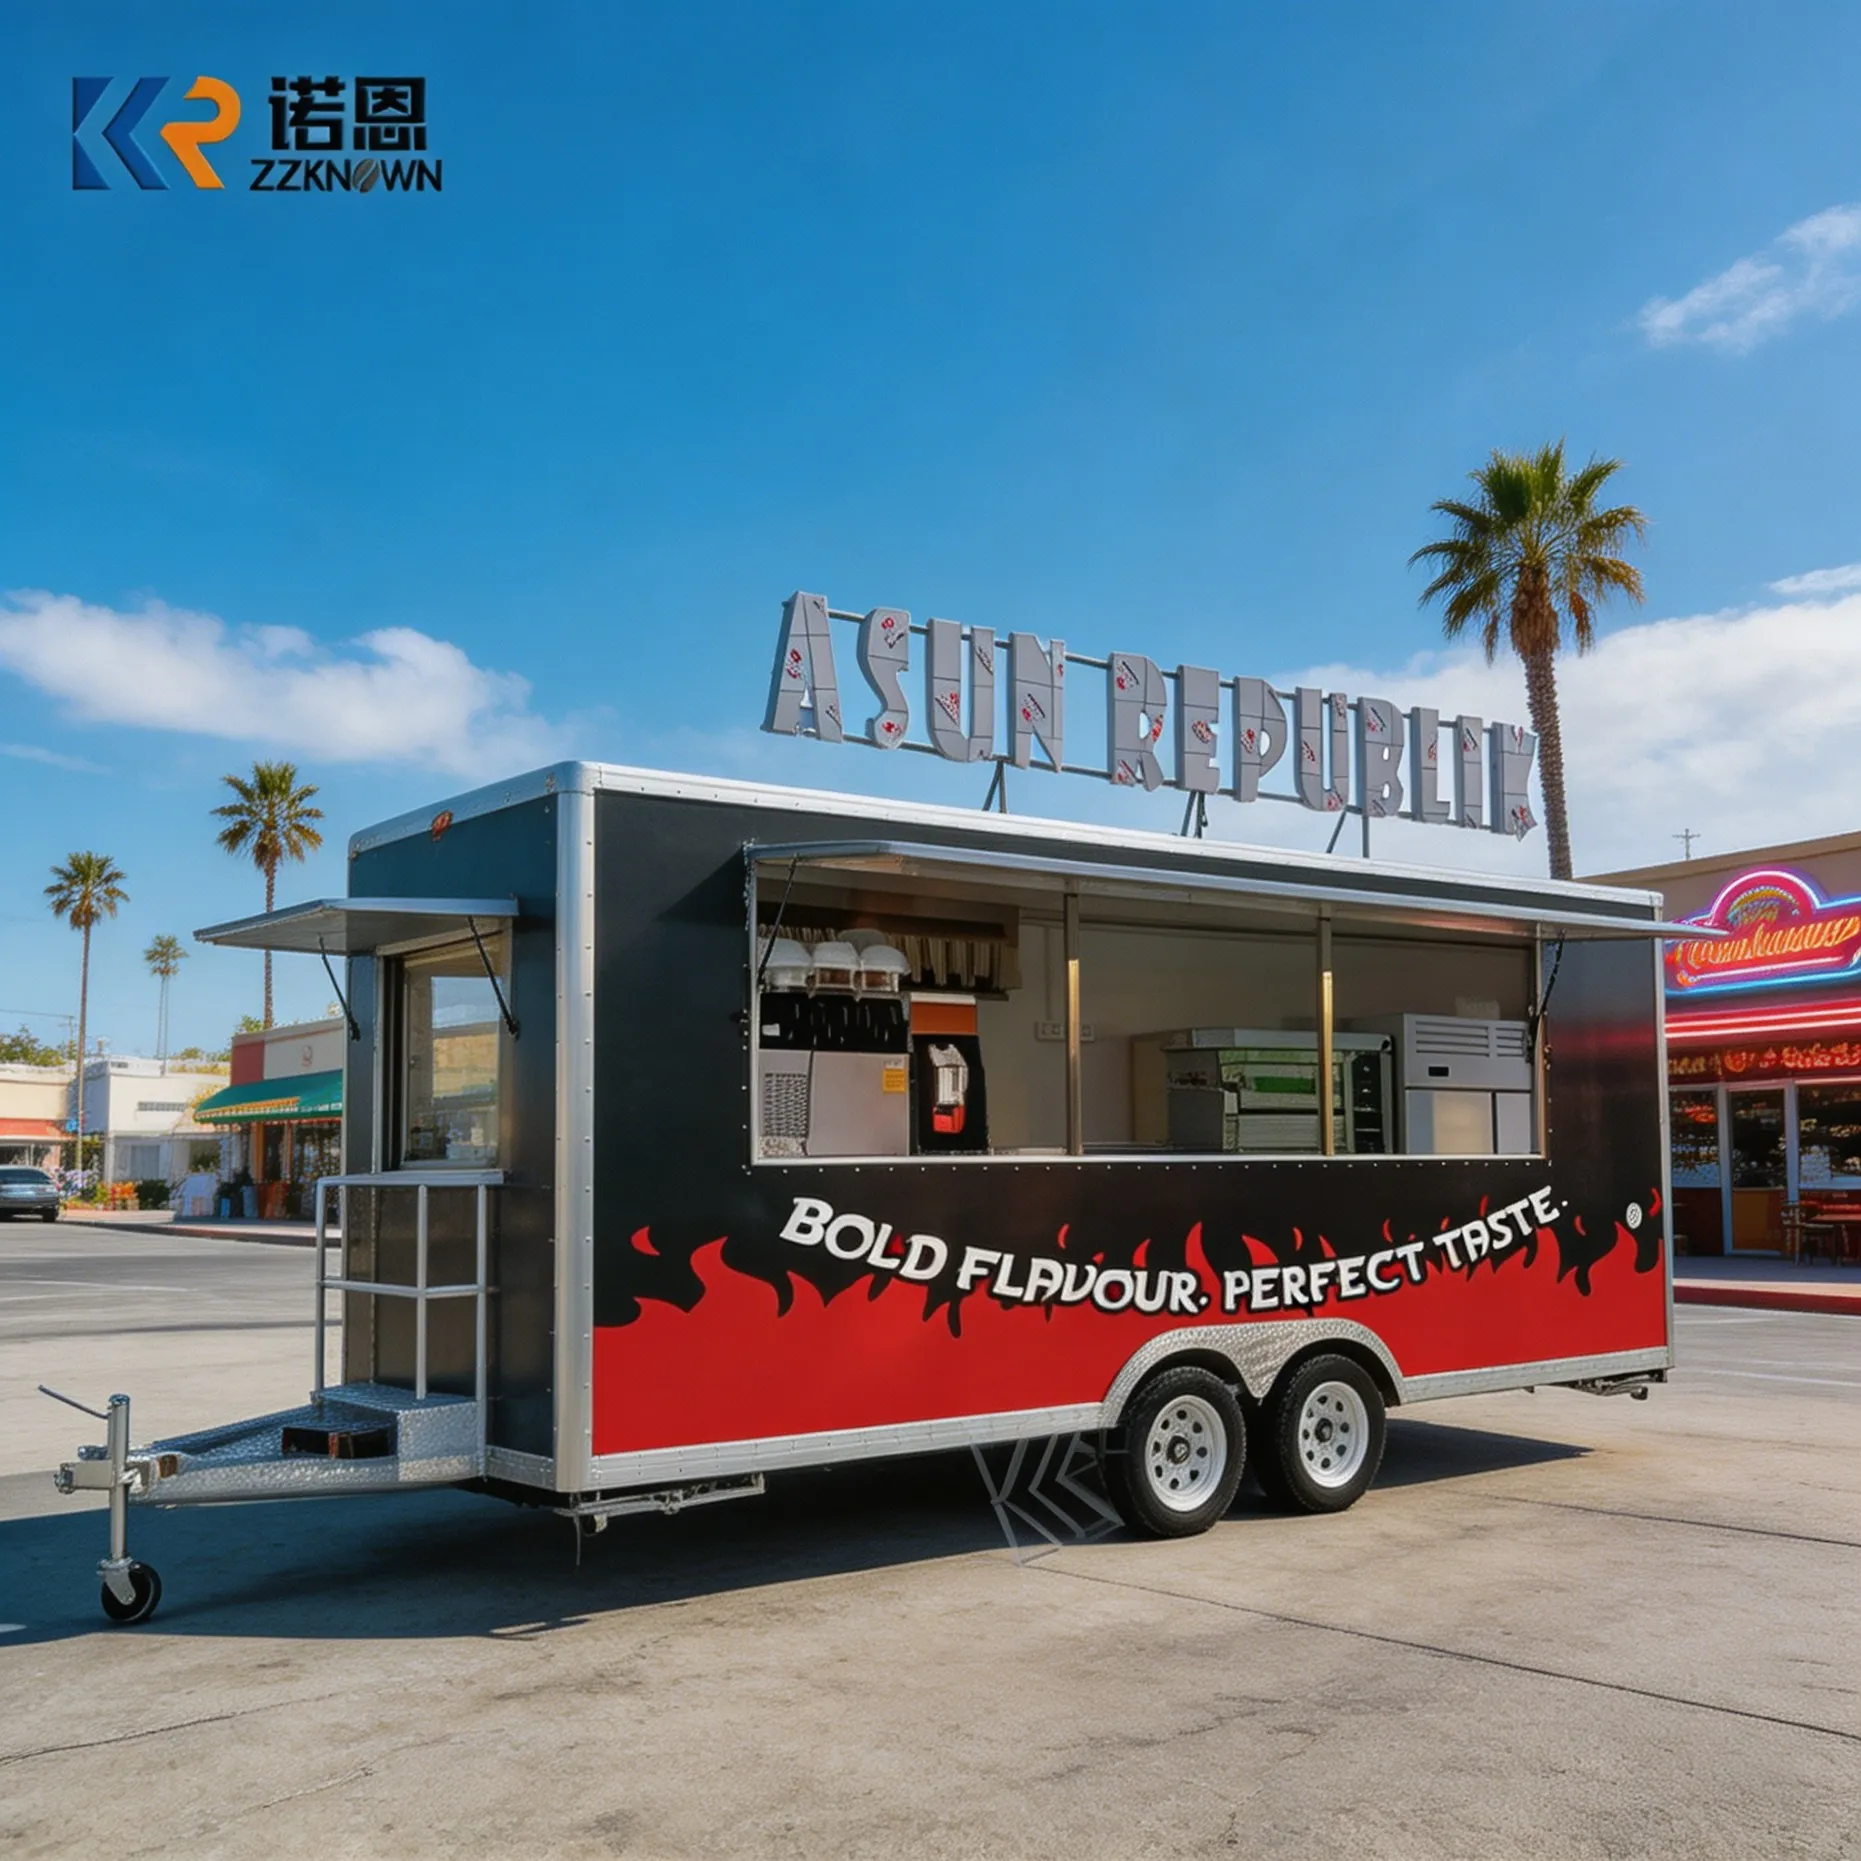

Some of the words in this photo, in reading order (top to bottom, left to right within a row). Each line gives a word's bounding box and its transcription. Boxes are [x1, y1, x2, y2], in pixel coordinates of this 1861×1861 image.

[1107, 652, 1538, 842] REPUBLIK
[779, 1197, 948, 1280] BOLD
[956, 1246, 1209, 1313] FLAVOUR.
[1223, 1242, 1424, 1311] PERFECT
[1433, 1185, 1568, 1268] TASTE.
